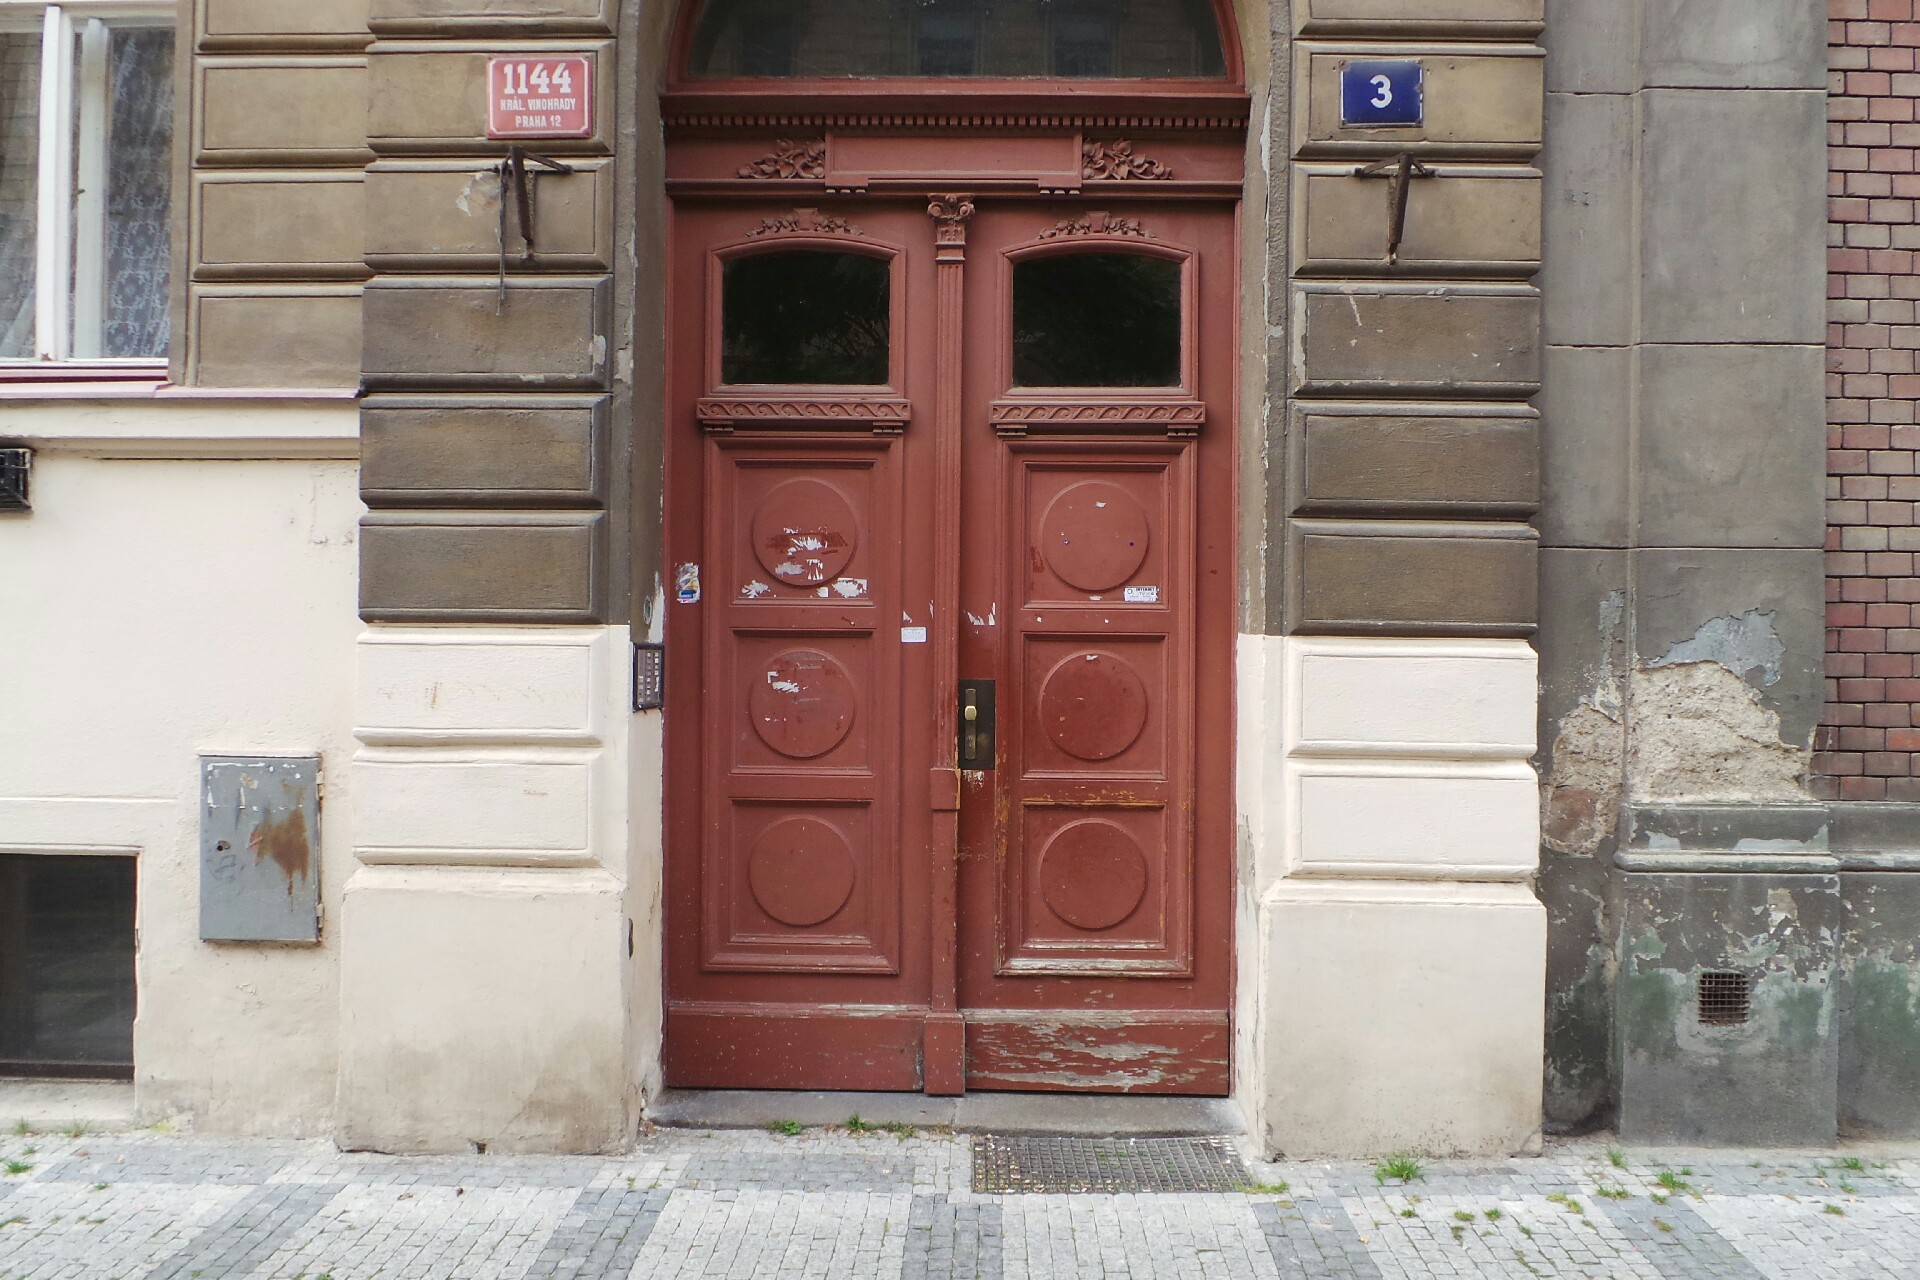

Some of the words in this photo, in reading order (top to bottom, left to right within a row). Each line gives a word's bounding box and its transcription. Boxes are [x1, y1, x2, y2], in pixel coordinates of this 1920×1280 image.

[503, 63, 572, 94] 1144
[1370, 74, 1393, 109] 3
[500, 96, 526, 111] KRÁL.
[527, 98, 576, 110] VINOHRADY
[515, 115, 547, 128] PRAHA
[549, 115, 562, 127] 12
